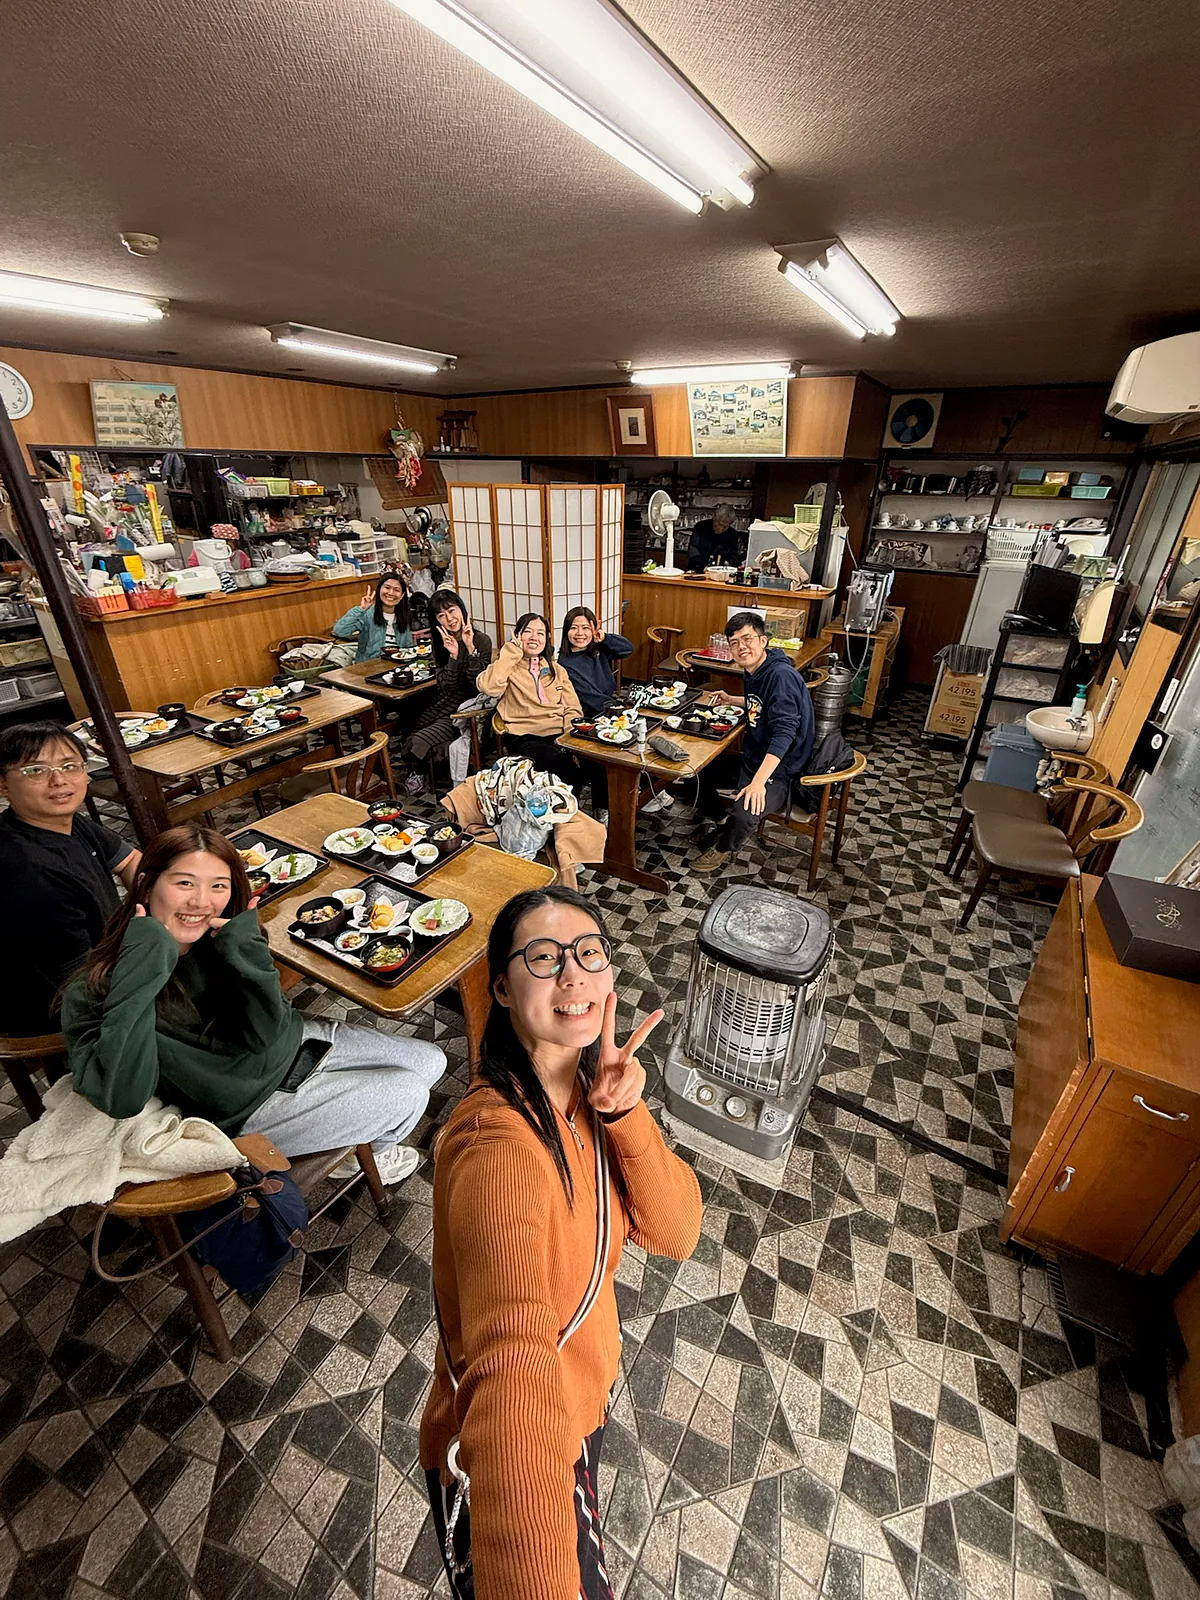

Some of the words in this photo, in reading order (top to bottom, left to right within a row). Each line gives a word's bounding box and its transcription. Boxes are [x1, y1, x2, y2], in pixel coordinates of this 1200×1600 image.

[10, 378, 17, 386] 2
[17, 387, 23, 395] 3
[948, 685, 976, 697] 42.195
[939, 713, 966, 724] 42.195
